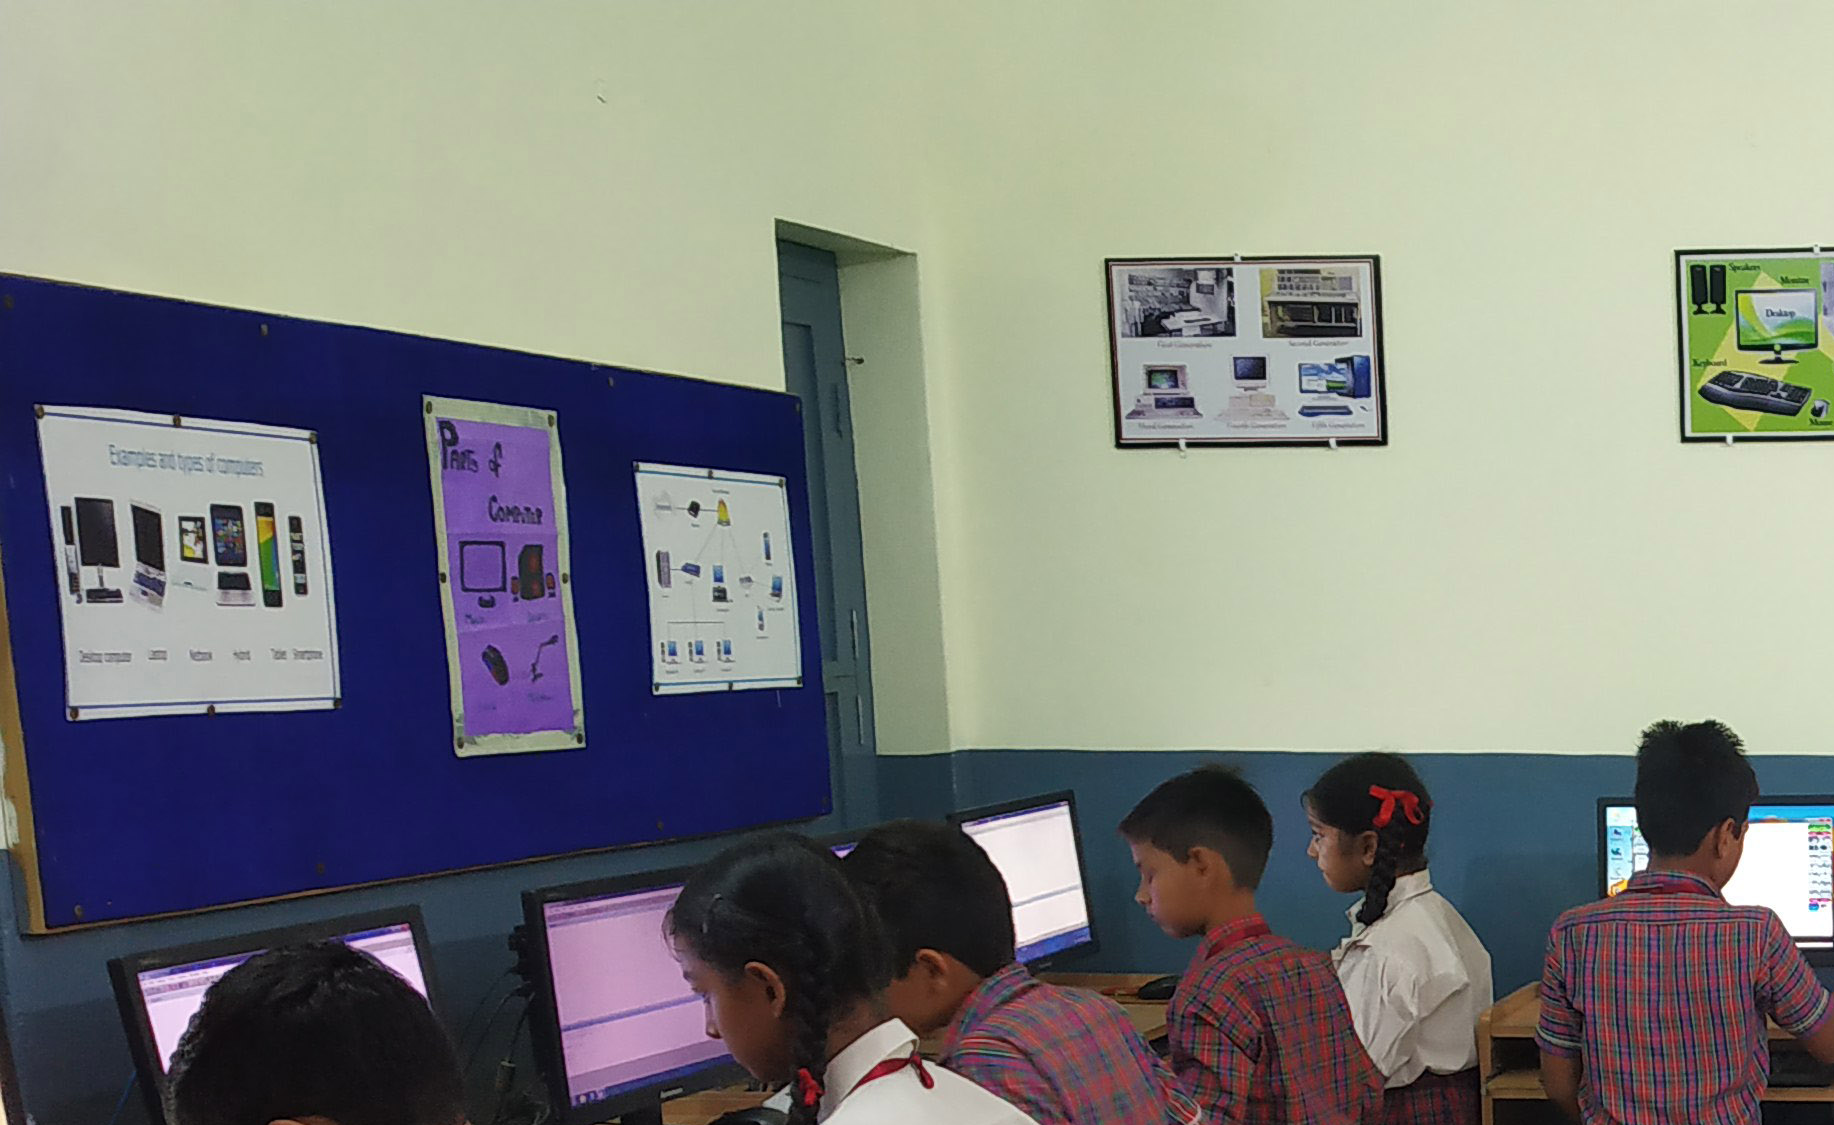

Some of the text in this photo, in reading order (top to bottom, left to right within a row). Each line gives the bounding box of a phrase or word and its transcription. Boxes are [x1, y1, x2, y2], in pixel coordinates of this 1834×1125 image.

[1728, 263, 1761, 272] Speakers
[1779, 276, 1809, 285] Monitor
[1765, 308, 1796, 319] Desktop
[1692, 358, 1728, 368] Keyboard
[1808, 418, 1833, 427] Mouse
[109, 444, 264, 478] Examples and types of computers
[488, 442, 503, 478] of
